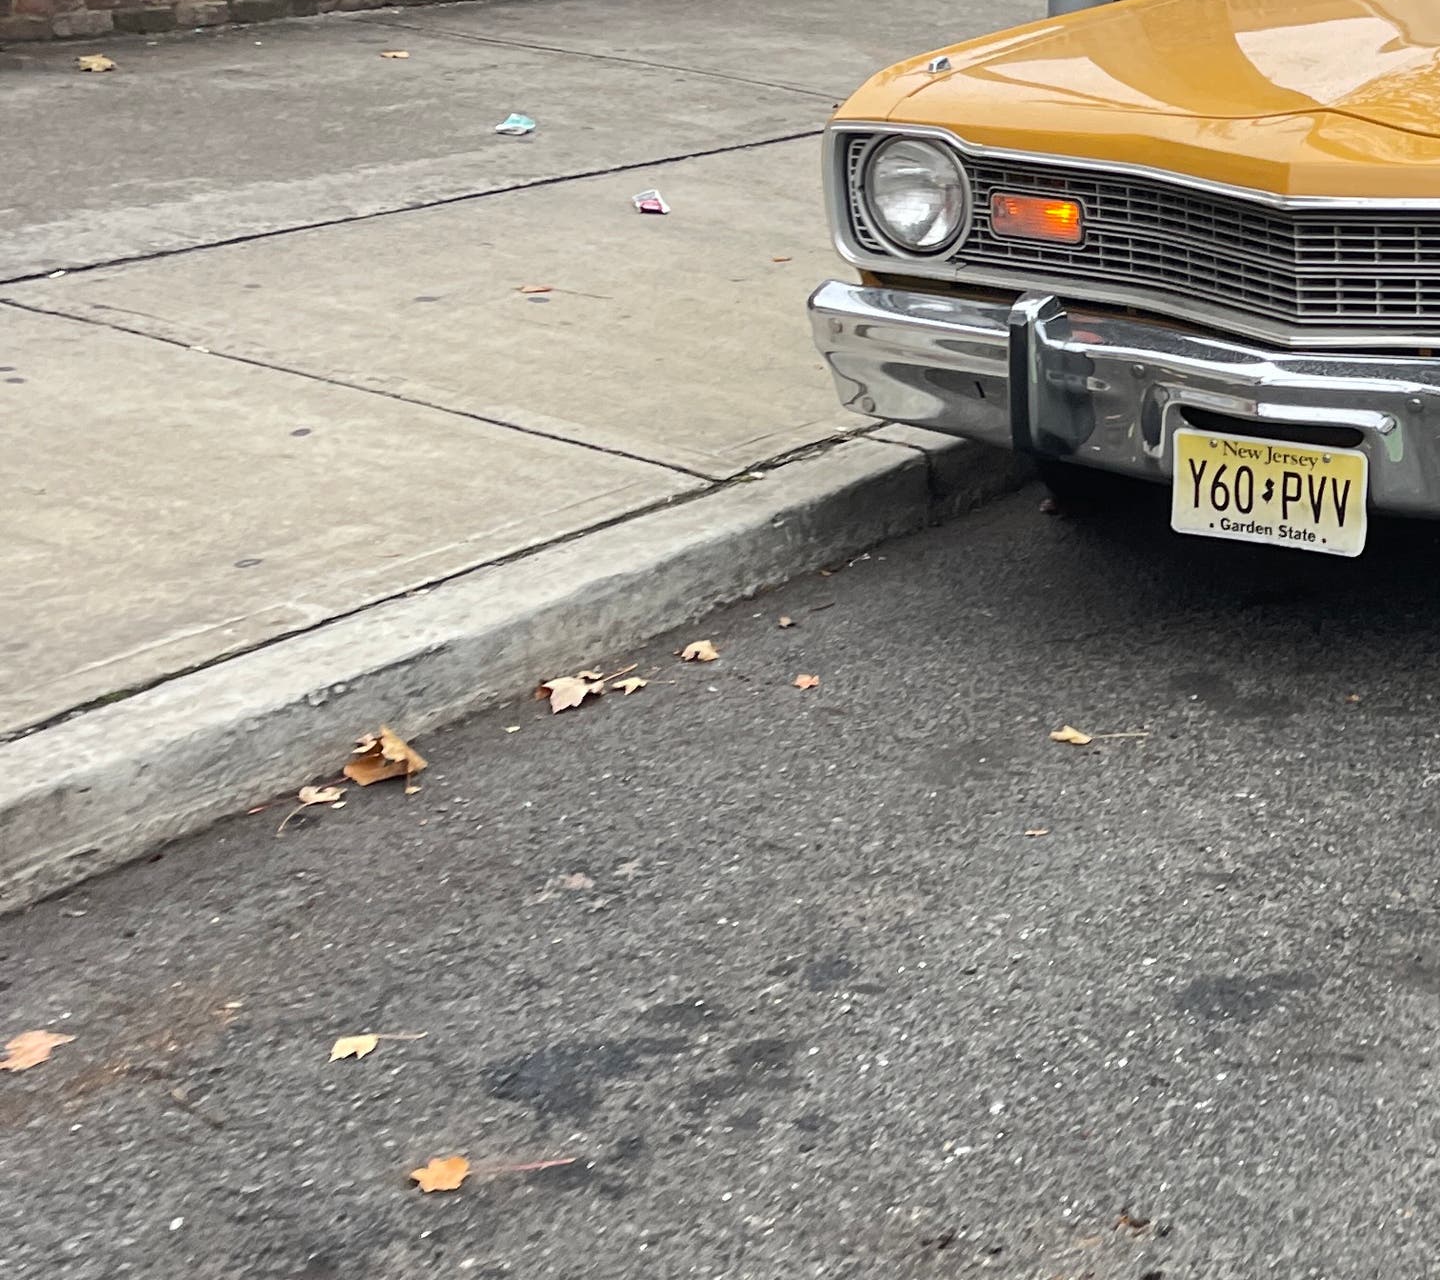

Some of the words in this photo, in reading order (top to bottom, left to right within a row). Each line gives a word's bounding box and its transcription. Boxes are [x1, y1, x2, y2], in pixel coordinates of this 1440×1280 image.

[1223, 440, 1262, 461] New
[1265, 446, 1318, 470] Jersey
[1188, 457, 1254, 515] Y60
[1281, 471, 1352, 528] PVV
[1220, 518, 1273, 536] Garden
[1278, 526, 1316, 543] State
